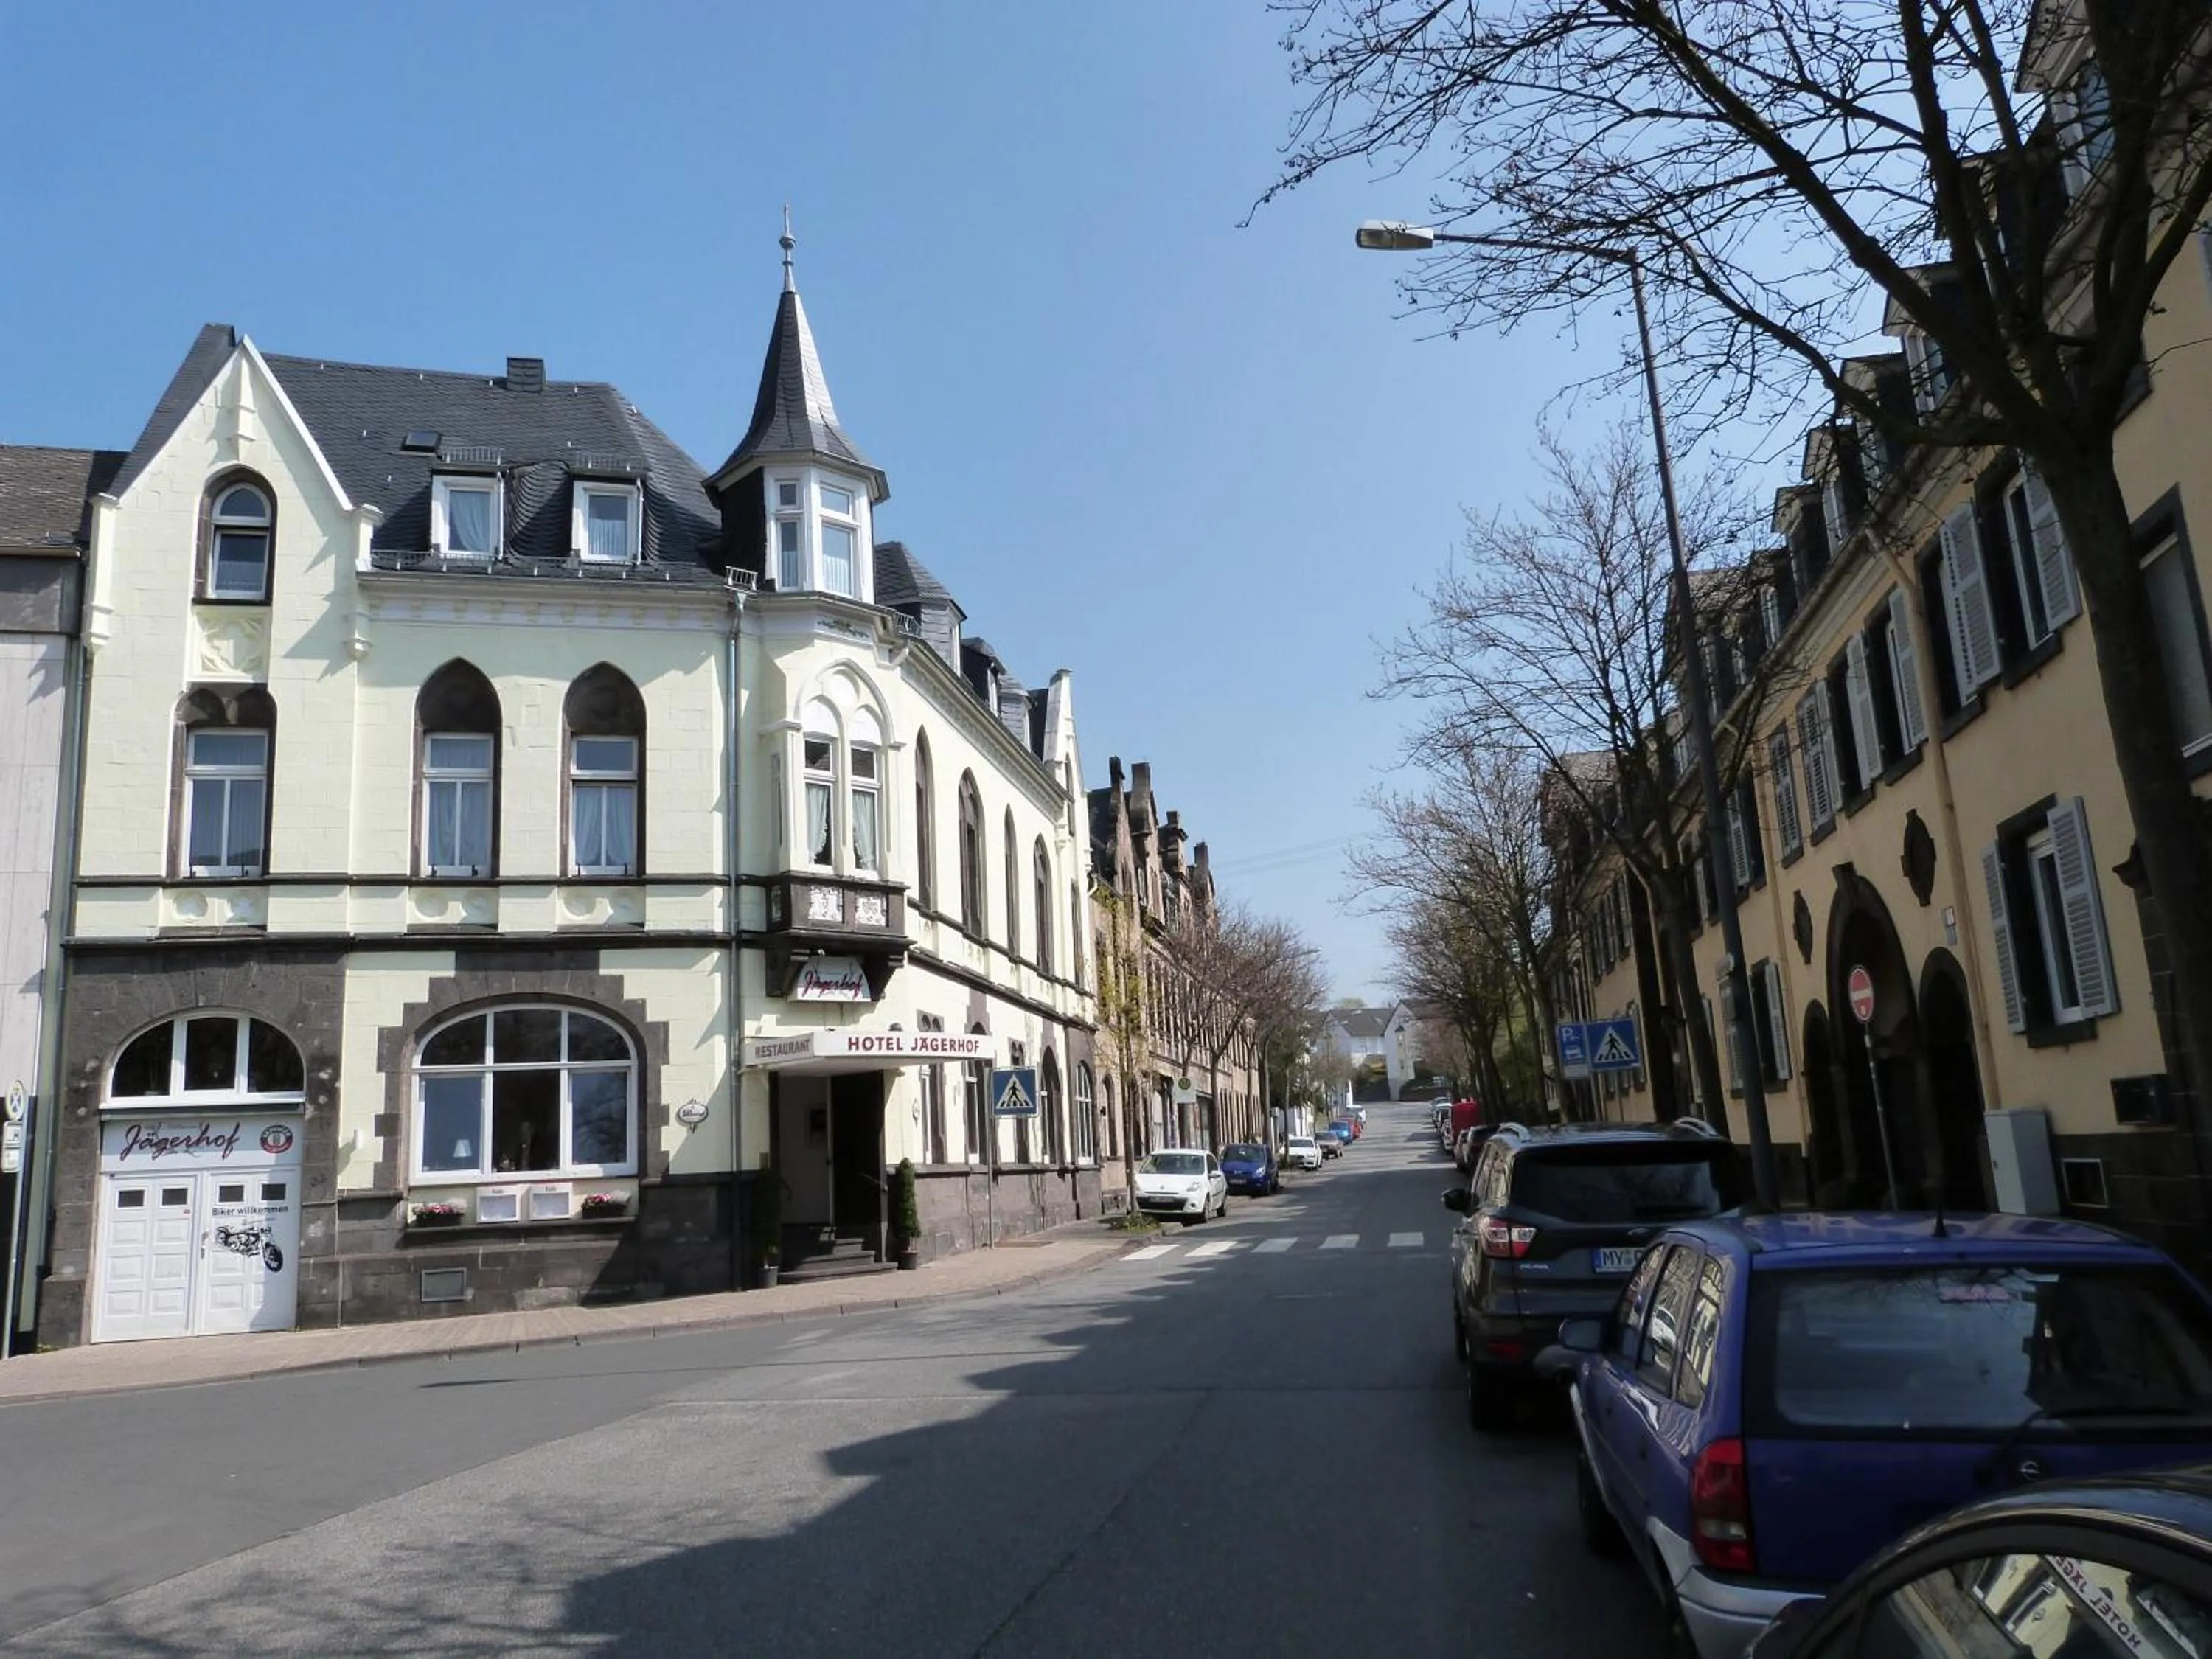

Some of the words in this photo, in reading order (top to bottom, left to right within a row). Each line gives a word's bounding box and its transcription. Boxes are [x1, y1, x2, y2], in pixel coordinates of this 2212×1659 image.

[801, 970, 863, 1000] Jägerhof
[754, 1037, 810, 1059] RESTAURANT
[848, 1036, 903, 1051] HOTEL
[911, 1036, 980, 1054] JÄGERHOF
[119, 1121, 240, 1162] Jägerhof
[212, 1207, 234, 1216] Biker
[237, 1206, 288, 1214] willkommen
